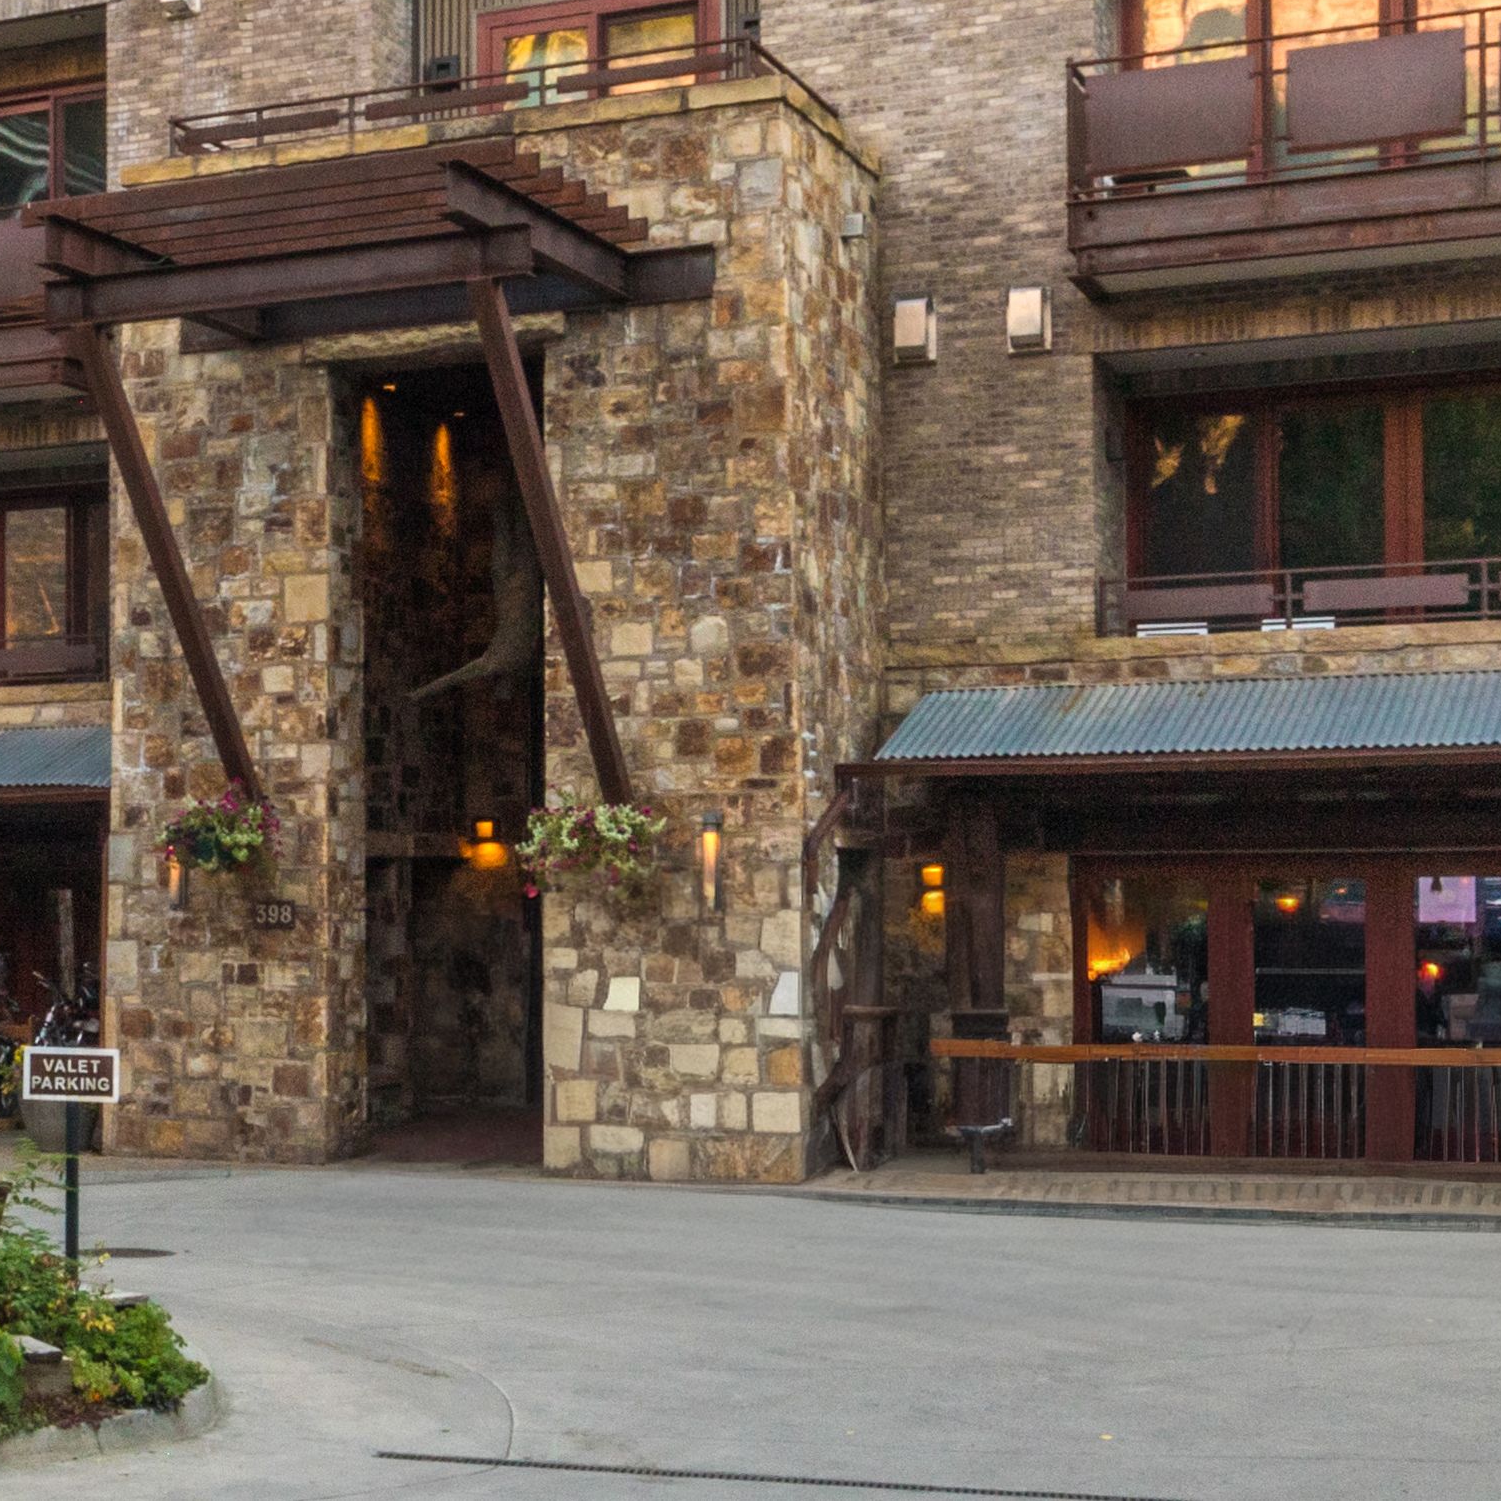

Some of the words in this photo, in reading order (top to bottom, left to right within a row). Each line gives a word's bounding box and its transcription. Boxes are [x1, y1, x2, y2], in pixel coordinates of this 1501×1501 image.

[256, 904, 292, 924] 398
[43, 1058, 101, 1074] VALET
[31, 1076, 110, 1091] PARKING
